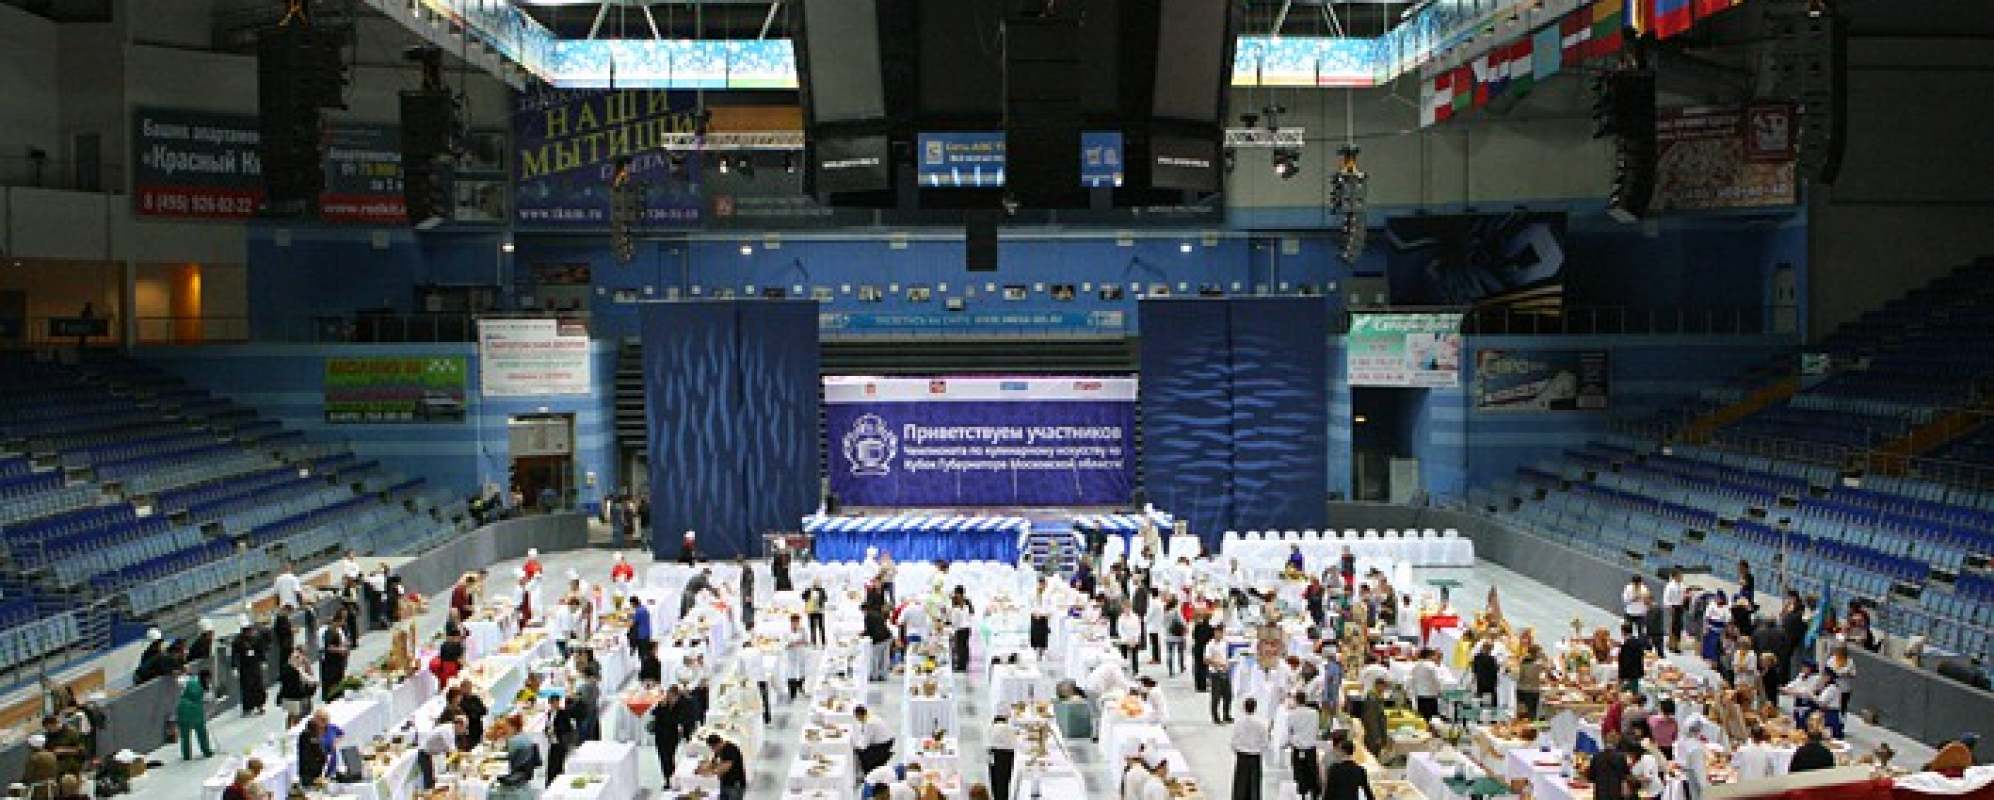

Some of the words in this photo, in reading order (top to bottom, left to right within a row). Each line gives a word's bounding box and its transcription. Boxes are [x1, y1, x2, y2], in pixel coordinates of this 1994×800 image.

[545, 89, 670, 140] НАШИ
[520, 112, 695, 181] МЫТИЩИ
[904, 423, 1023, 445] Приветствуем
[1027, 425, 1122, 445] участников
